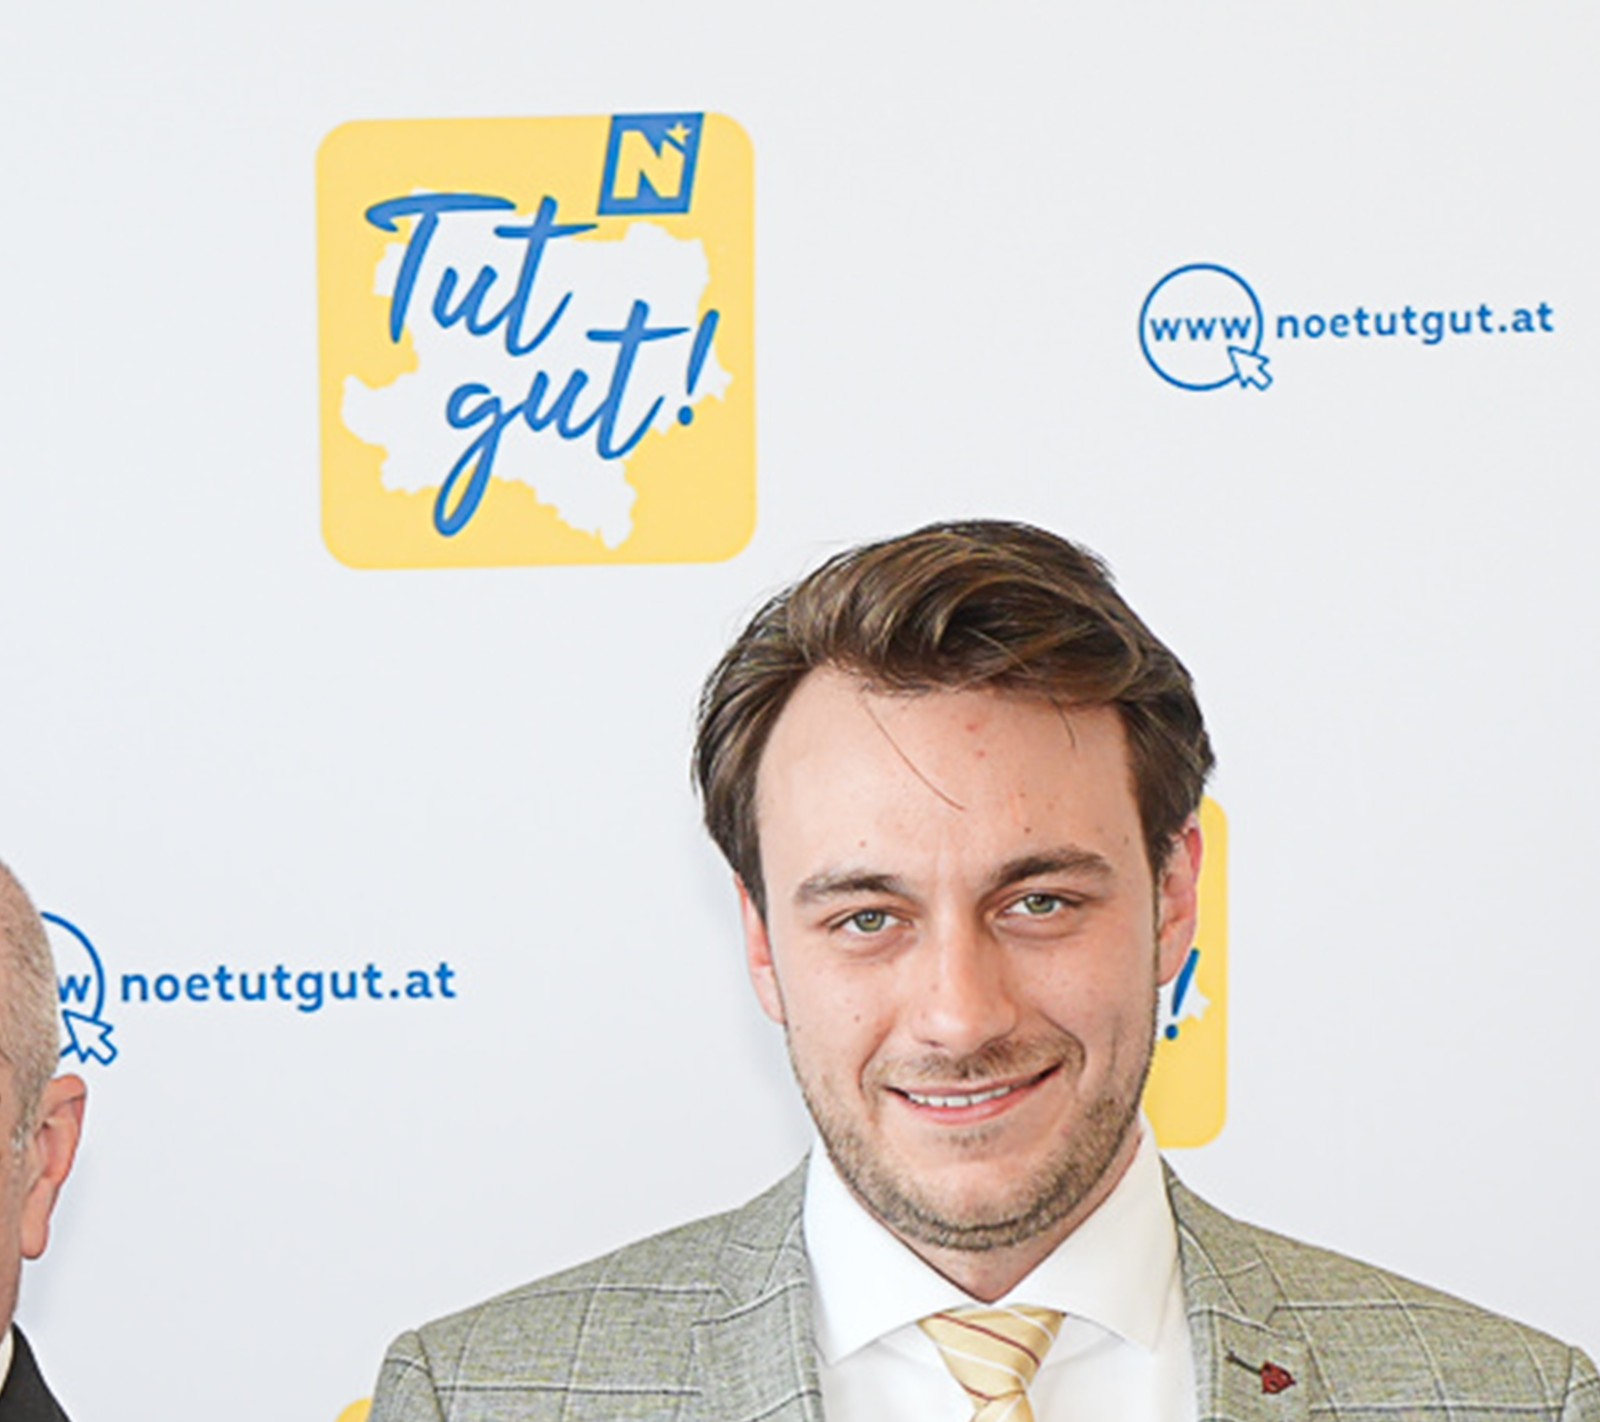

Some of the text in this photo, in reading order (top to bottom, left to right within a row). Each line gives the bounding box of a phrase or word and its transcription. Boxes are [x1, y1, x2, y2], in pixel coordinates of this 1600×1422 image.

[367, 193, 595, 358] Tut
[1151, 302, 1554, 346] www noetutgut.at
[435, 299, 720, 537] gut!
[121, 962, 457, 1014] noetutgut.at
